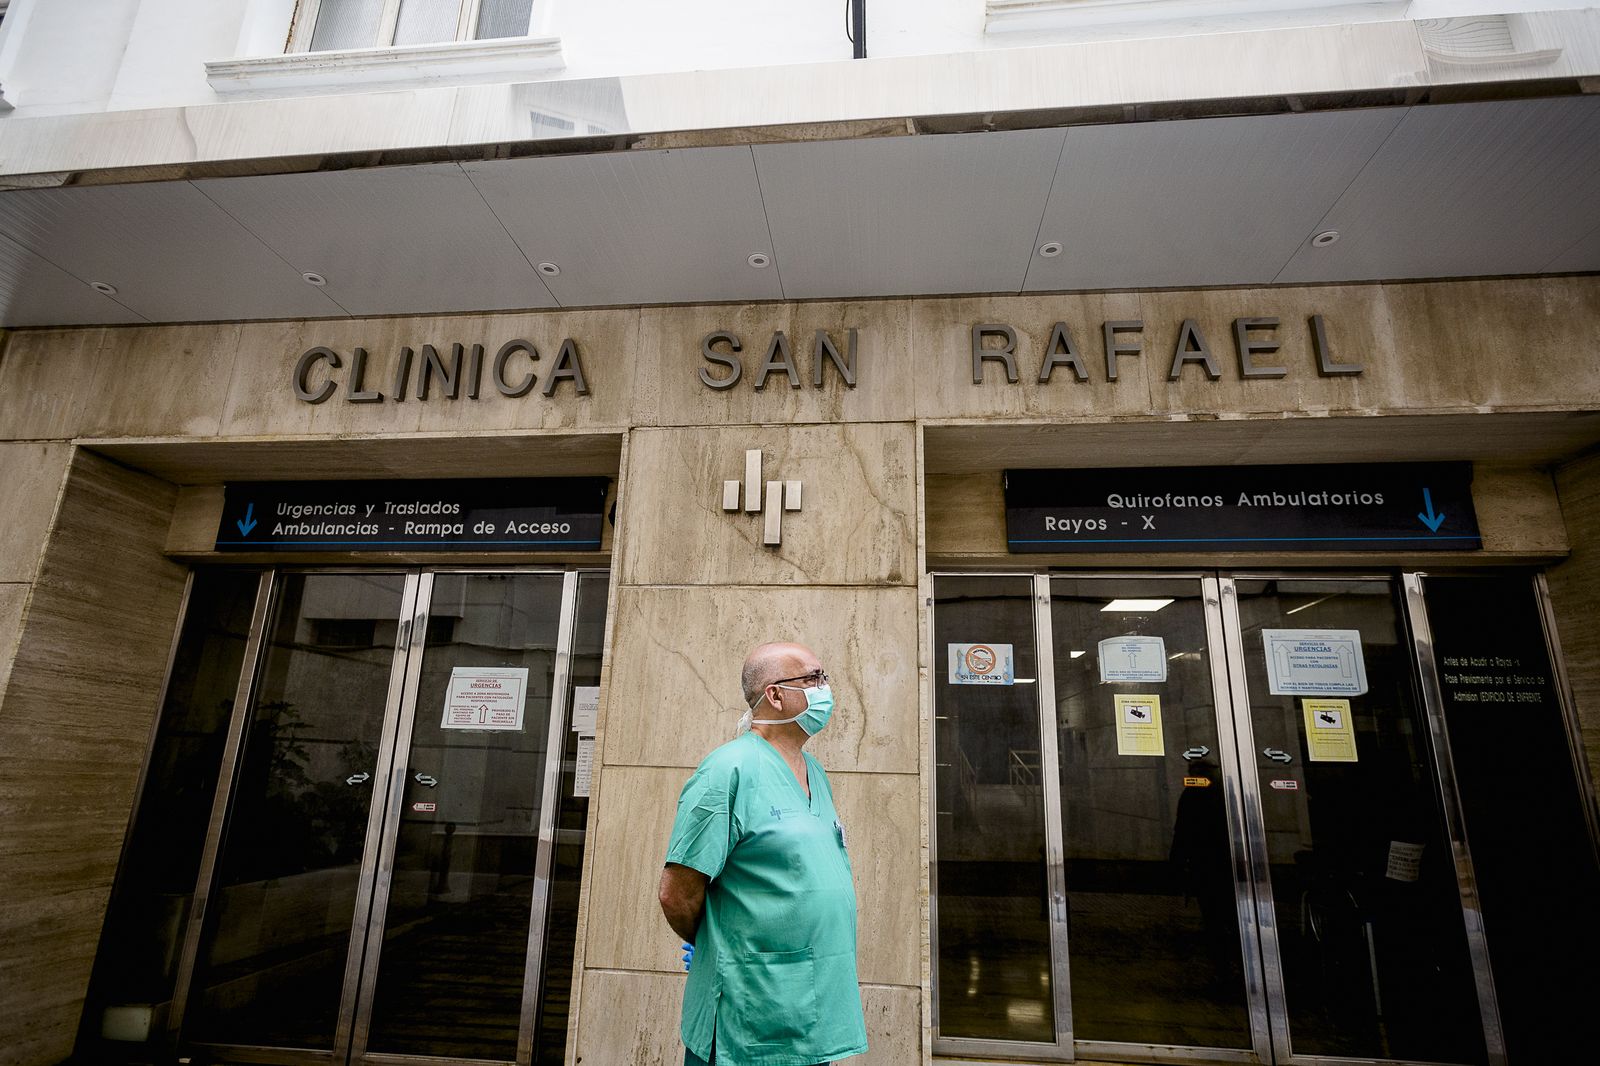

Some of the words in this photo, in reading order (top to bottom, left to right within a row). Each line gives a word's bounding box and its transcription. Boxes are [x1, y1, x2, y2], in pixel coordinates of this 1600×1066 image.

[292, 337, 589, 404] CLINICA
[698, 328, 858, 391] SAN
[972, 314, 1363, 384] RAFAEL
[1107, 493, 1224, 508] Quirofanos
[1237, 491, 1384, 506] Ambulatorios
[277, 502, 356, 519] Urgencias
[366, 504, 375, 518] y
[384, 501, 460, 515] Traslados
[272, 522, 379, 536] Ambulancias
[404, 521, 464, 538] Rampa
[473, 521, 495, 535] de
[505, 521, 571, 535] Acceso
[1045, 516, 1107, 534] Rayos
[1141, 515, 1156, 530] X
